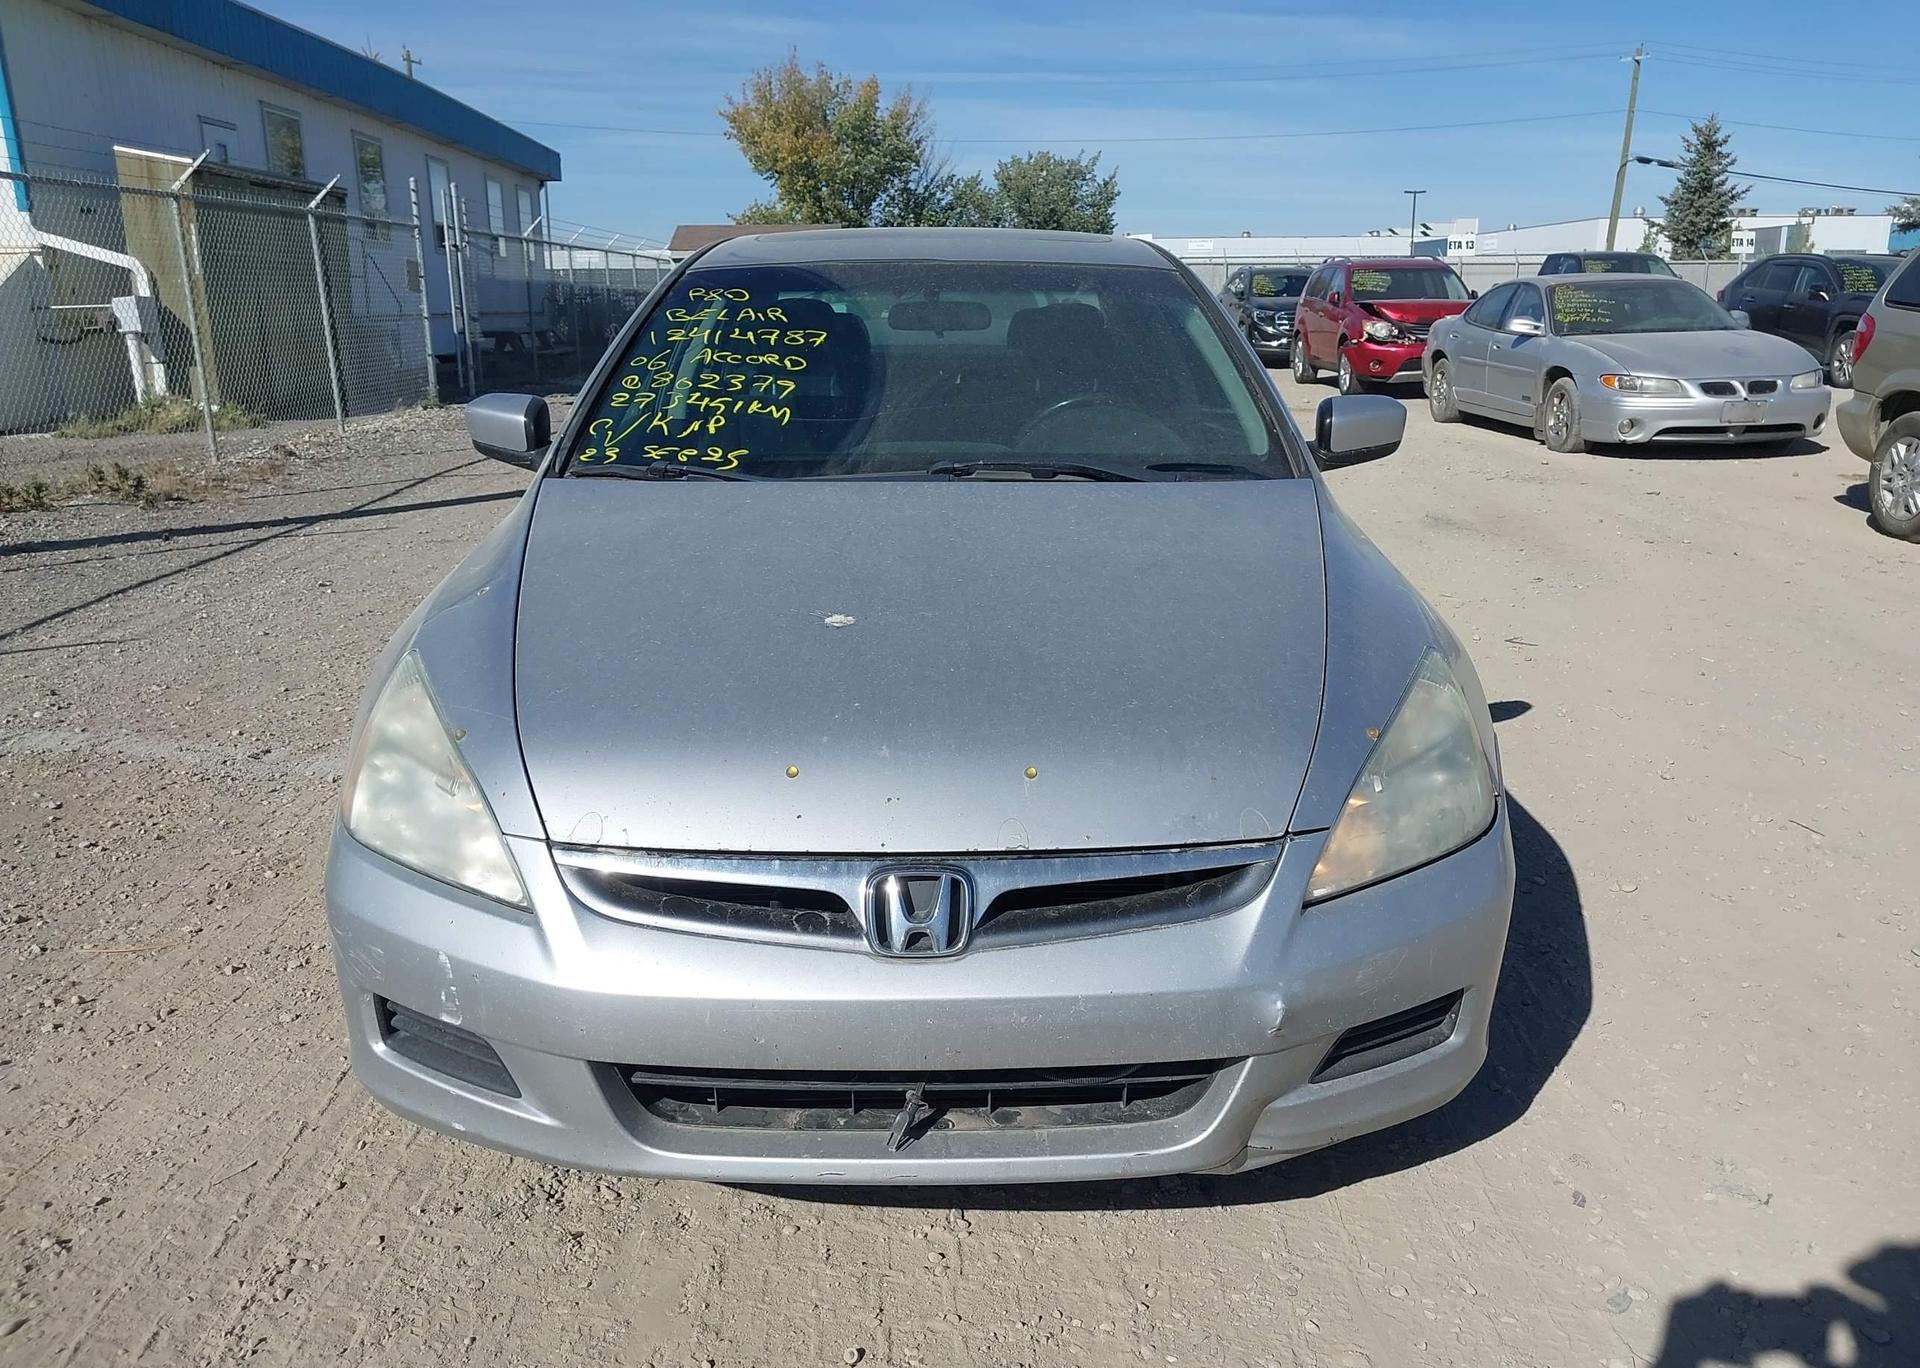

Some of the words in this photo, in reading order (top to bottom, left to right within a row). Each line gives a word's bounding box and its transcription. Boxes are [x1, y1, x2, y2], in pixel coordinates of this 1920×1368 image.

[1448, 240, 1463, 250] ETA
[1465, 240, 1475, 250] 13
[1732, 238, 1744, 247] ETA
[1746, 238, 1754, 247] 14
[690, 348, 807, 371] ACCORD
